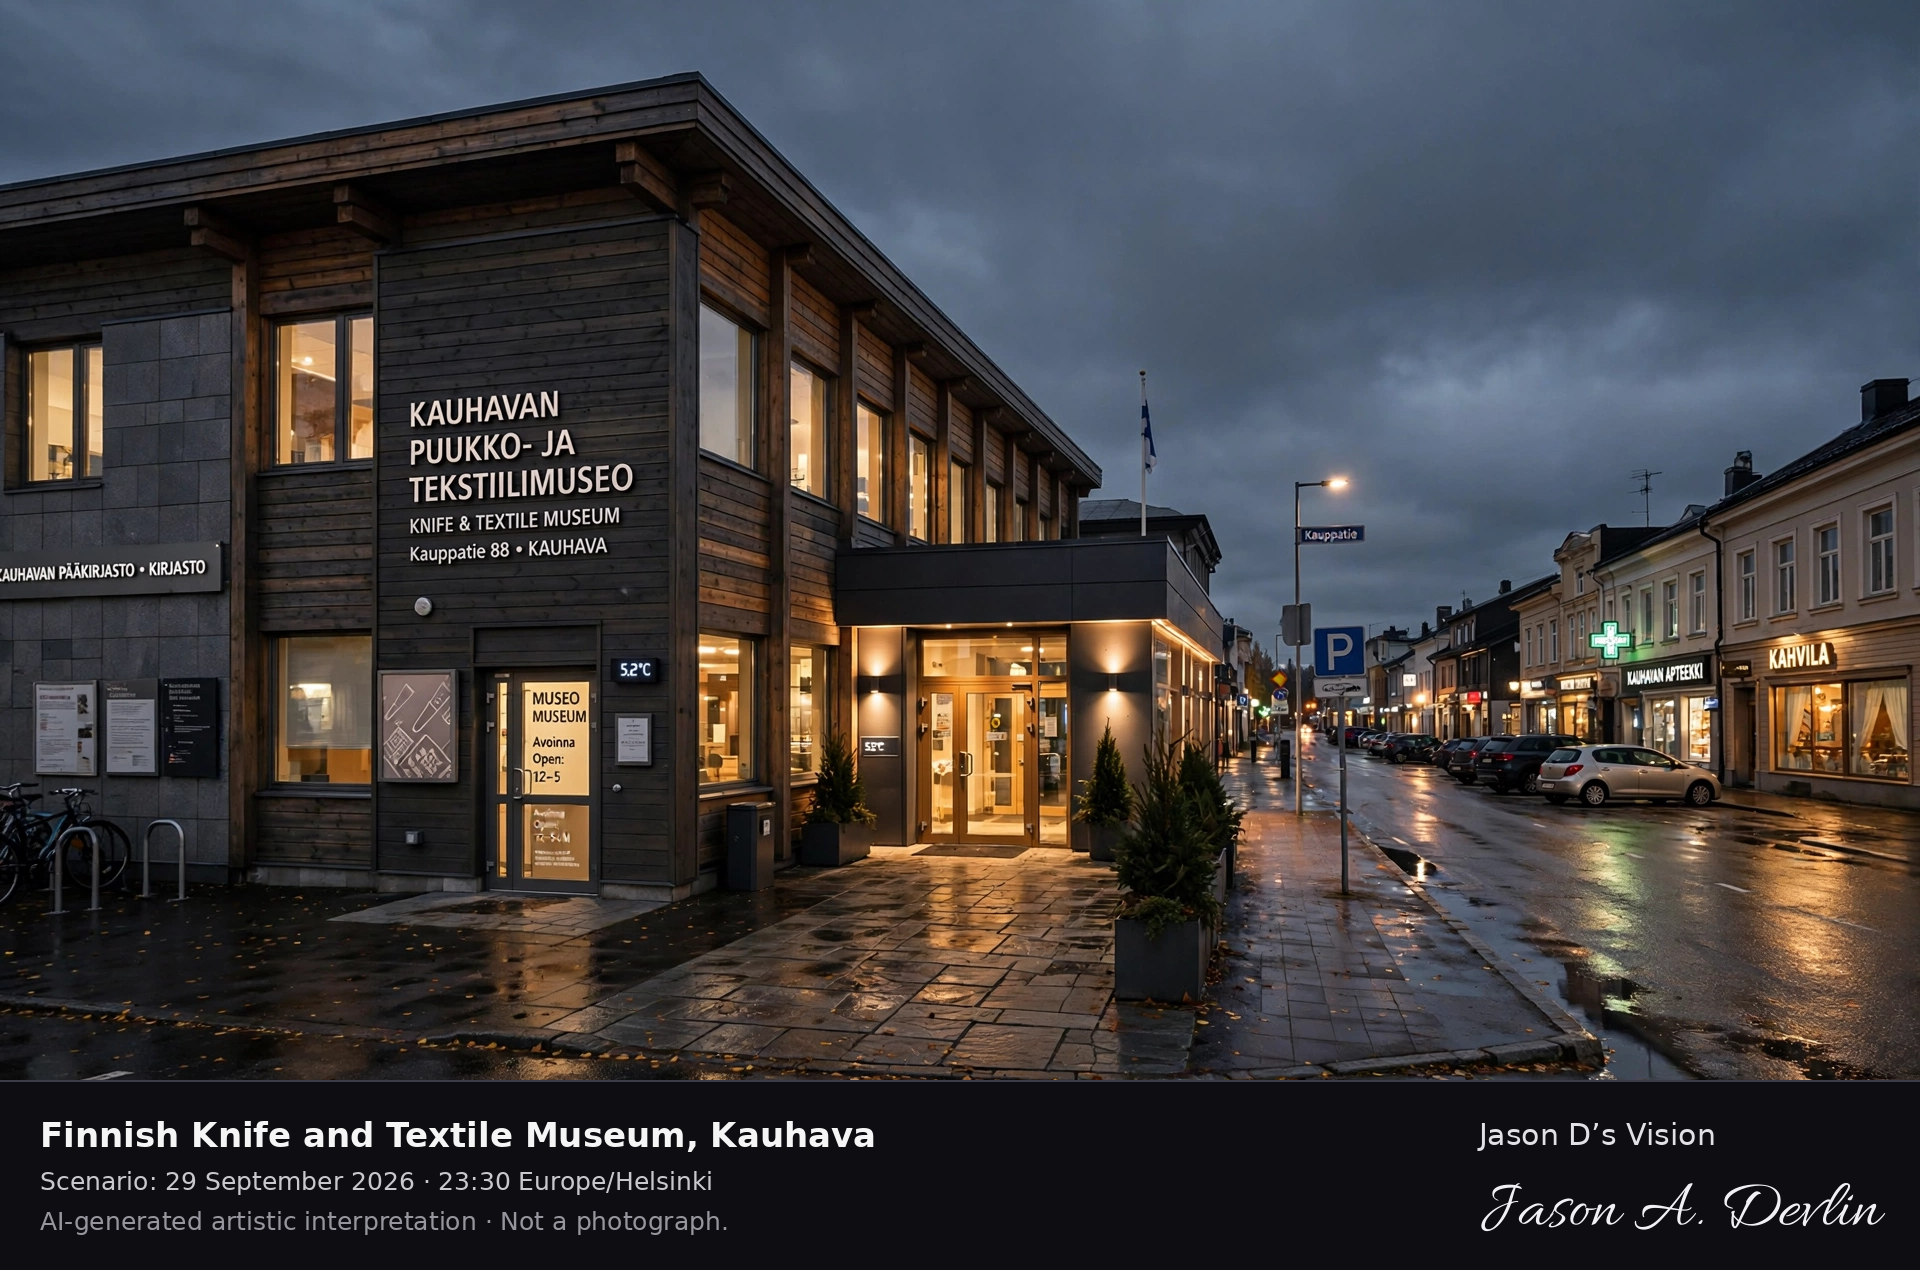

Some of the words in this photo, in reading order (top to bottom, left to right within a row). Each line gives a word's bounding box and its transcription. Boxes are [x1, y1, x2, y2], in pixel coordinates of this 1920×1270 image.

[410, 390, 559, 428] KAUHAVAN
[410, 432, 532, 465] PUUKKO-
[541, 429, 576, 457] JA
[409, 463, 634, 503] TEKSTIILIMUSEO
[409, 516, 454, 534] KNIFE
[459, 515, 471, 531] &
[475, 511, 538, 531] TEXTILE
[544, 507, 620, 527] MUSEUM
[1305, 528, 1358, 543] Kauppatie
[410, 543, 486, 565] Kauppatie
[490, 542, 510, 558] 88
[528, 537, 608, 557] KAUHAVA
[59, 562, 135, 580] PÄÄKIRJASTO
[149, 559, 206, 576] KIRJASTO
[1327, 633, 1353, 671] P
[1769, 642, 1830, 670] KAHVILA
[1665, 662, 1703, 682] APTEEKKI
[532, 691, 580, 705] MUSEO
[532, 710, 587, 723] MUSEUM
[532, 736, 575, 748] Avoinna
[532, 753, 564, 767] Open:
